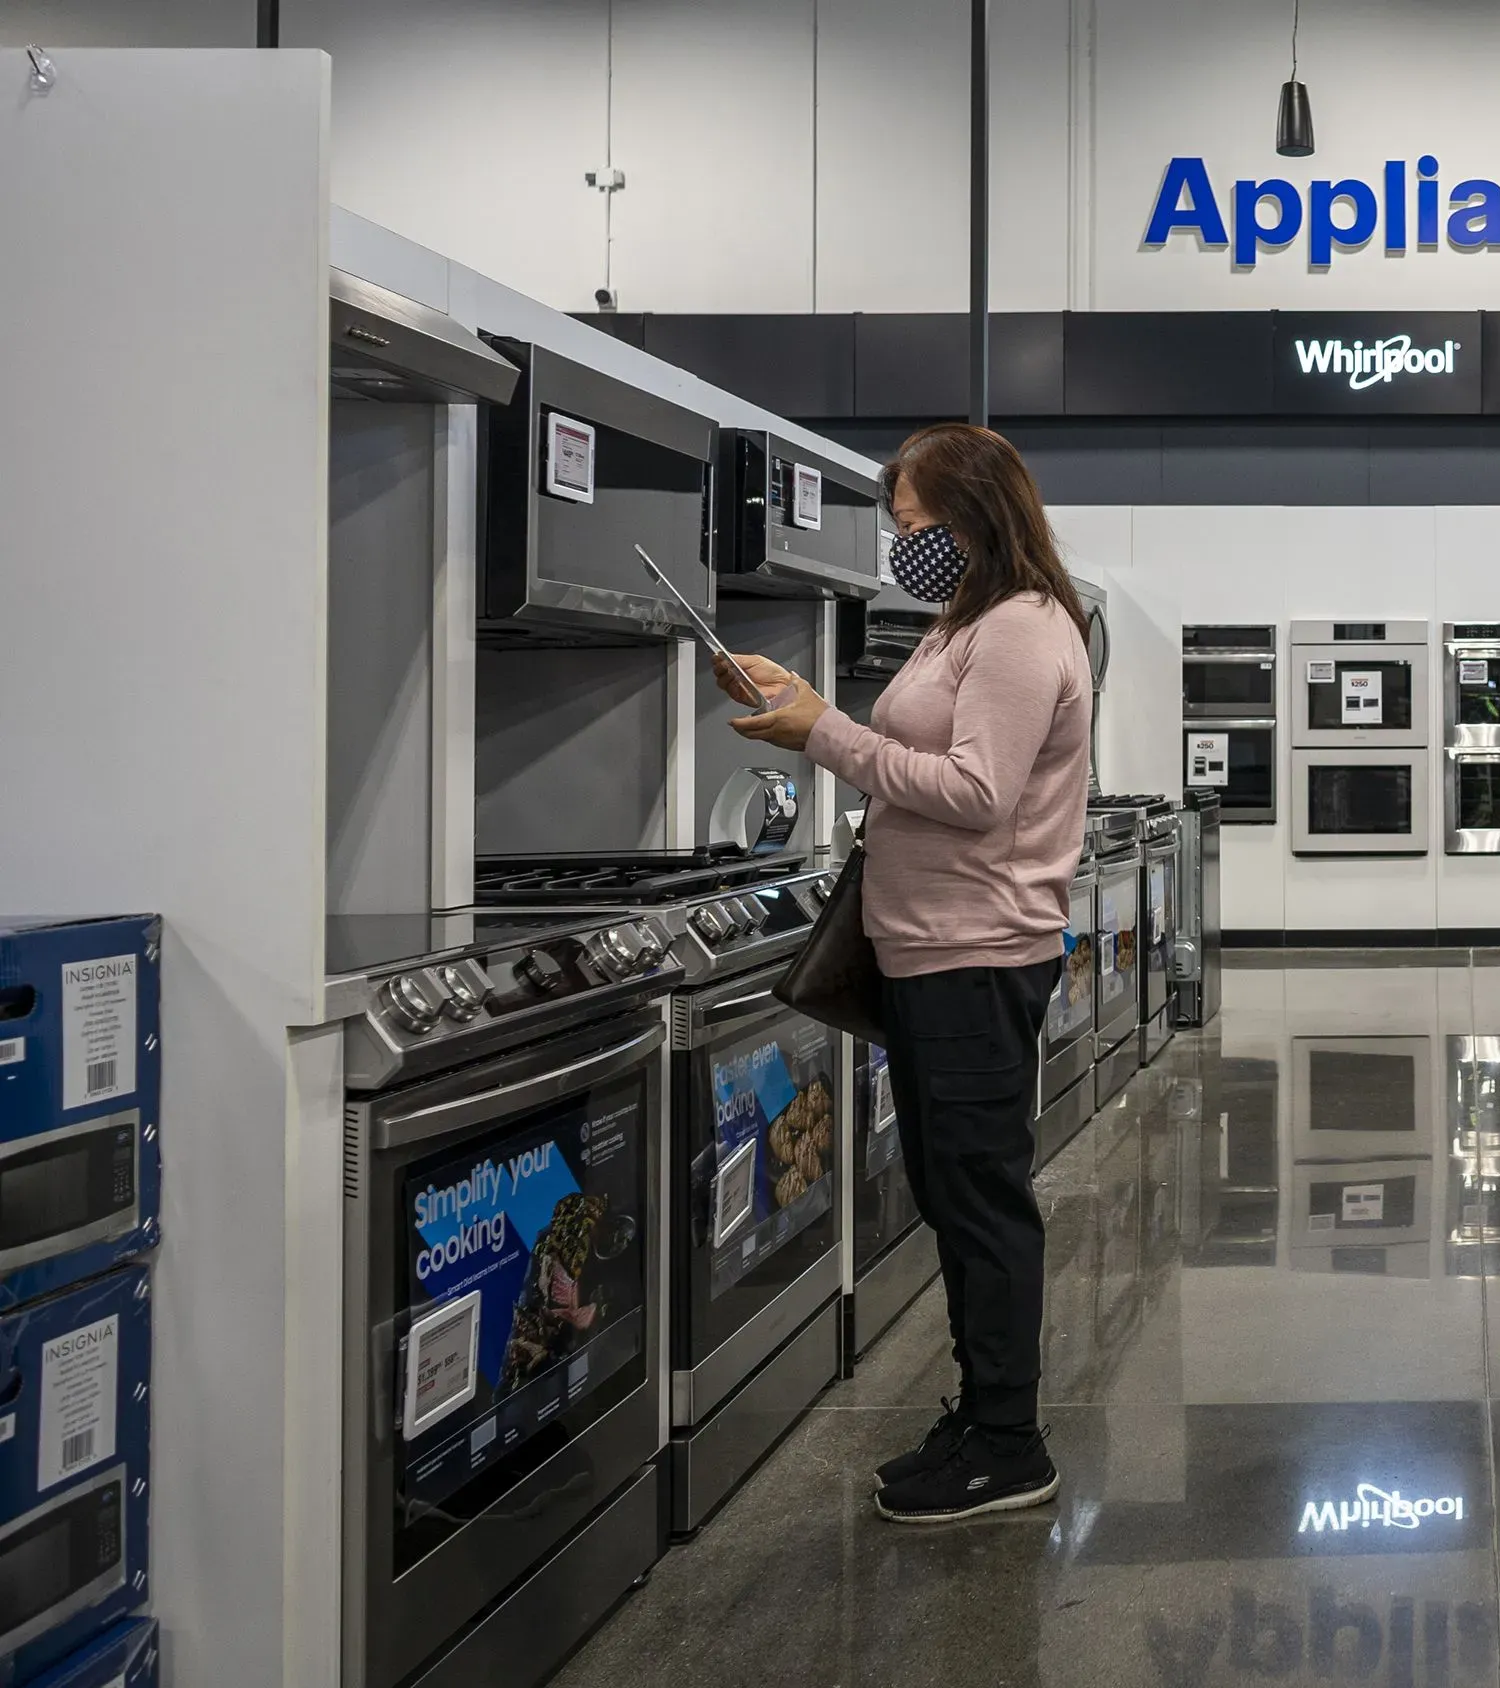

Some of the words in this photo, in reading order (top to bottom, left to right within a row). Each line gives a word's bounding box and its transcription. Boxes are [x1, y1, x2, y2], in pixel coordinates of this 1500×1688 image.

[1296, 337, 1460, 389] Whirlpool
[65, 963, 133, 985] INSIGNIA
[713, 1054, 749, 1089] Faster
[752, 1041, 778, 1069] even
[716, 1089, 755, 1126] baking
[414, 1159, 502, 1228] Simplify
[509, 1141, 553, 1196] your
[416, 1210, 506, 1280] cooking
[45, 1324, 114, 1363] INSIGNIA
